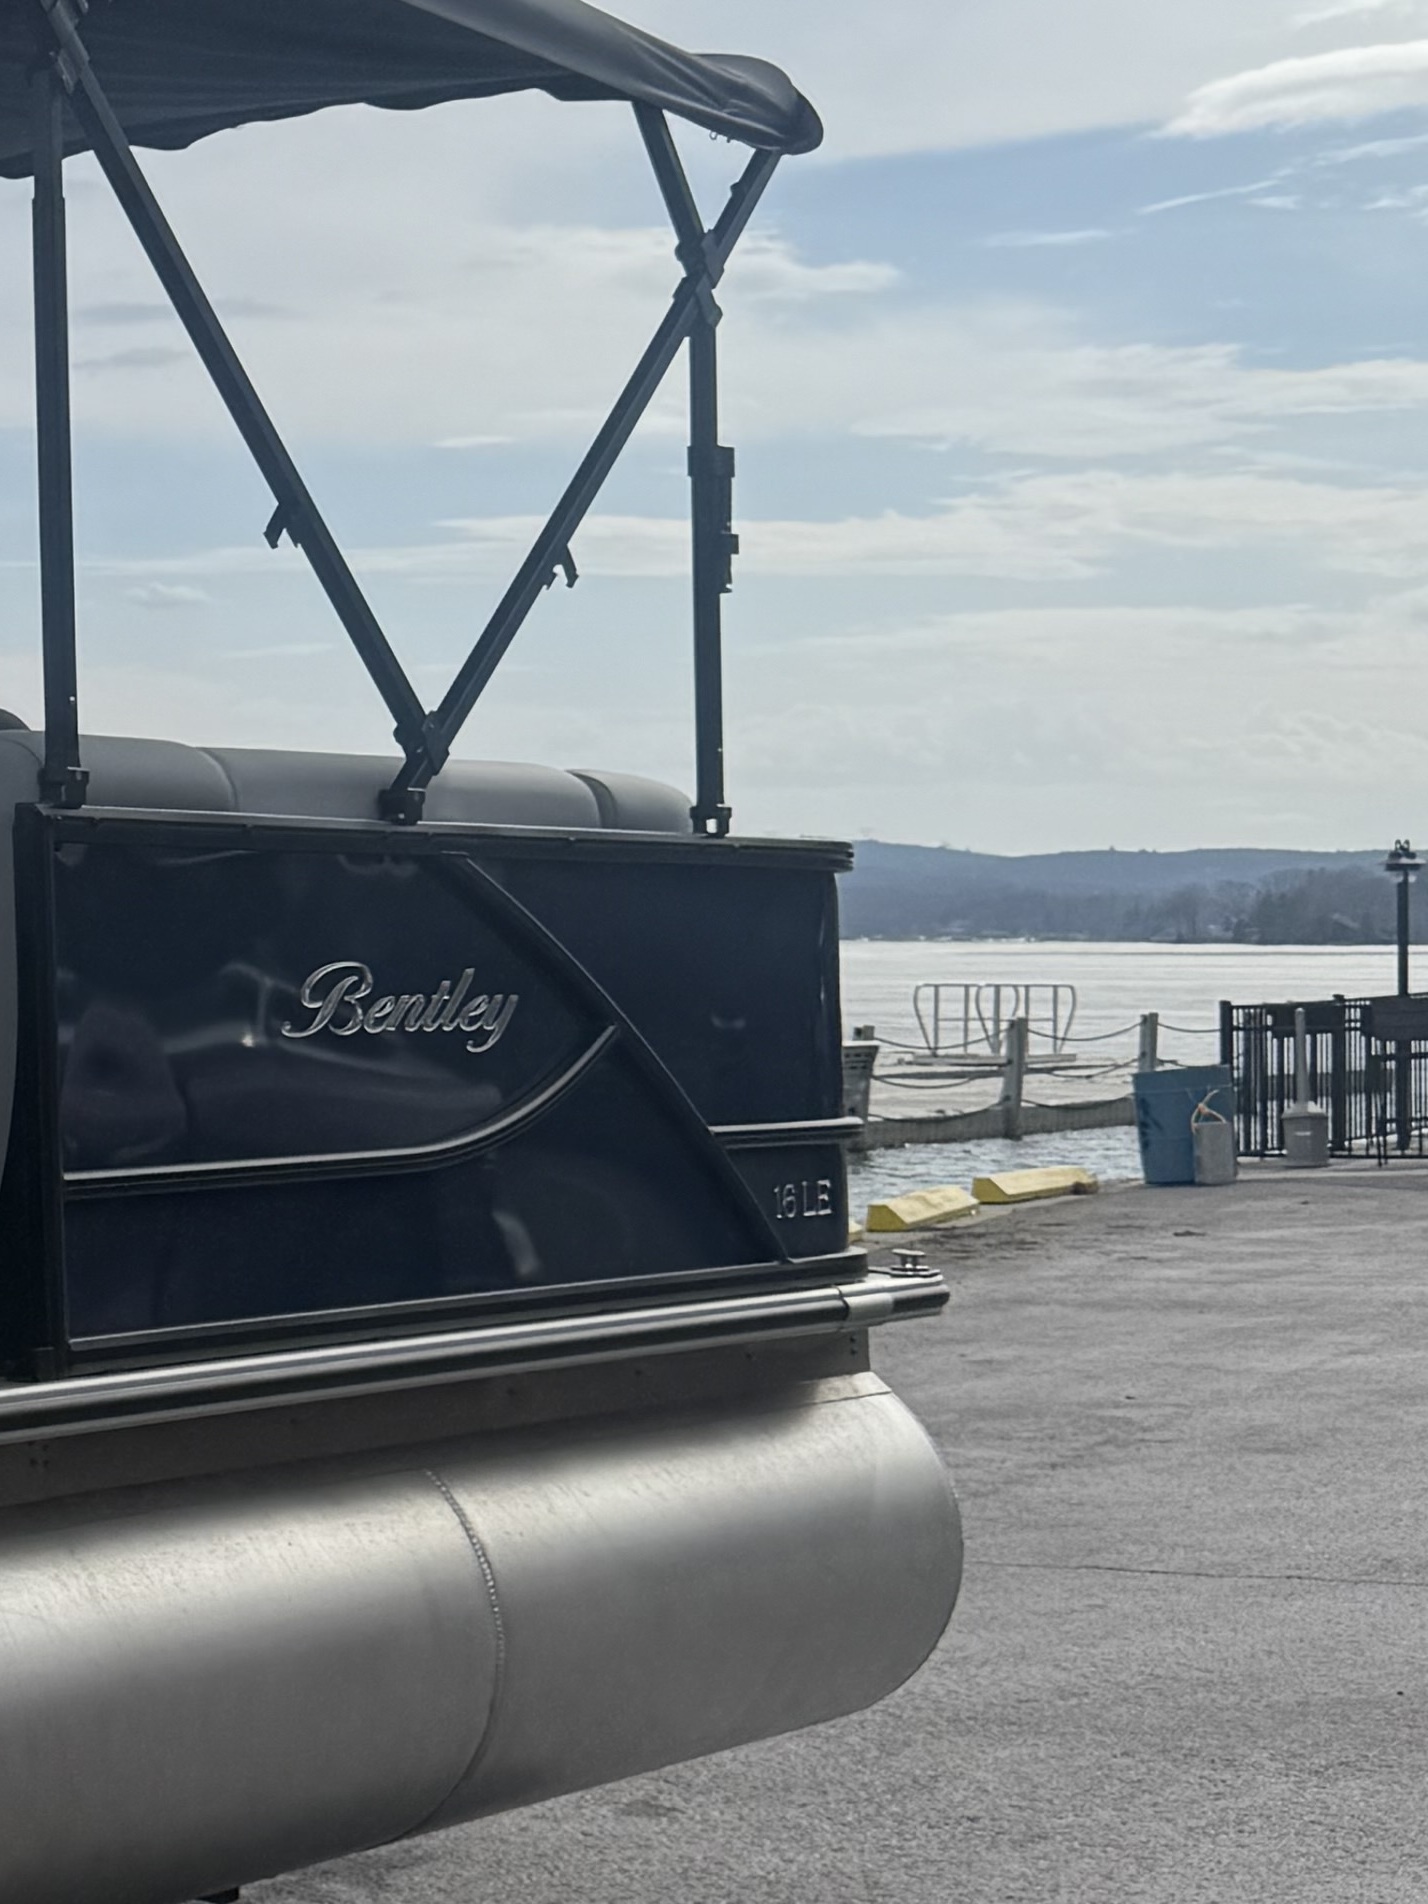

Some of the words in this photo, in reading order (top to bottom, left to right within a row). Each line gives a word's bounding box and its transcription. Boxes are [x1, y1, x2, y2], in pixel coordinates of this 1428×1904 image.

[281, 961, 519, 1053] Bentley
[773, 1184, 796, 1218] 16
[802, 1179, 832, 1216] LE
